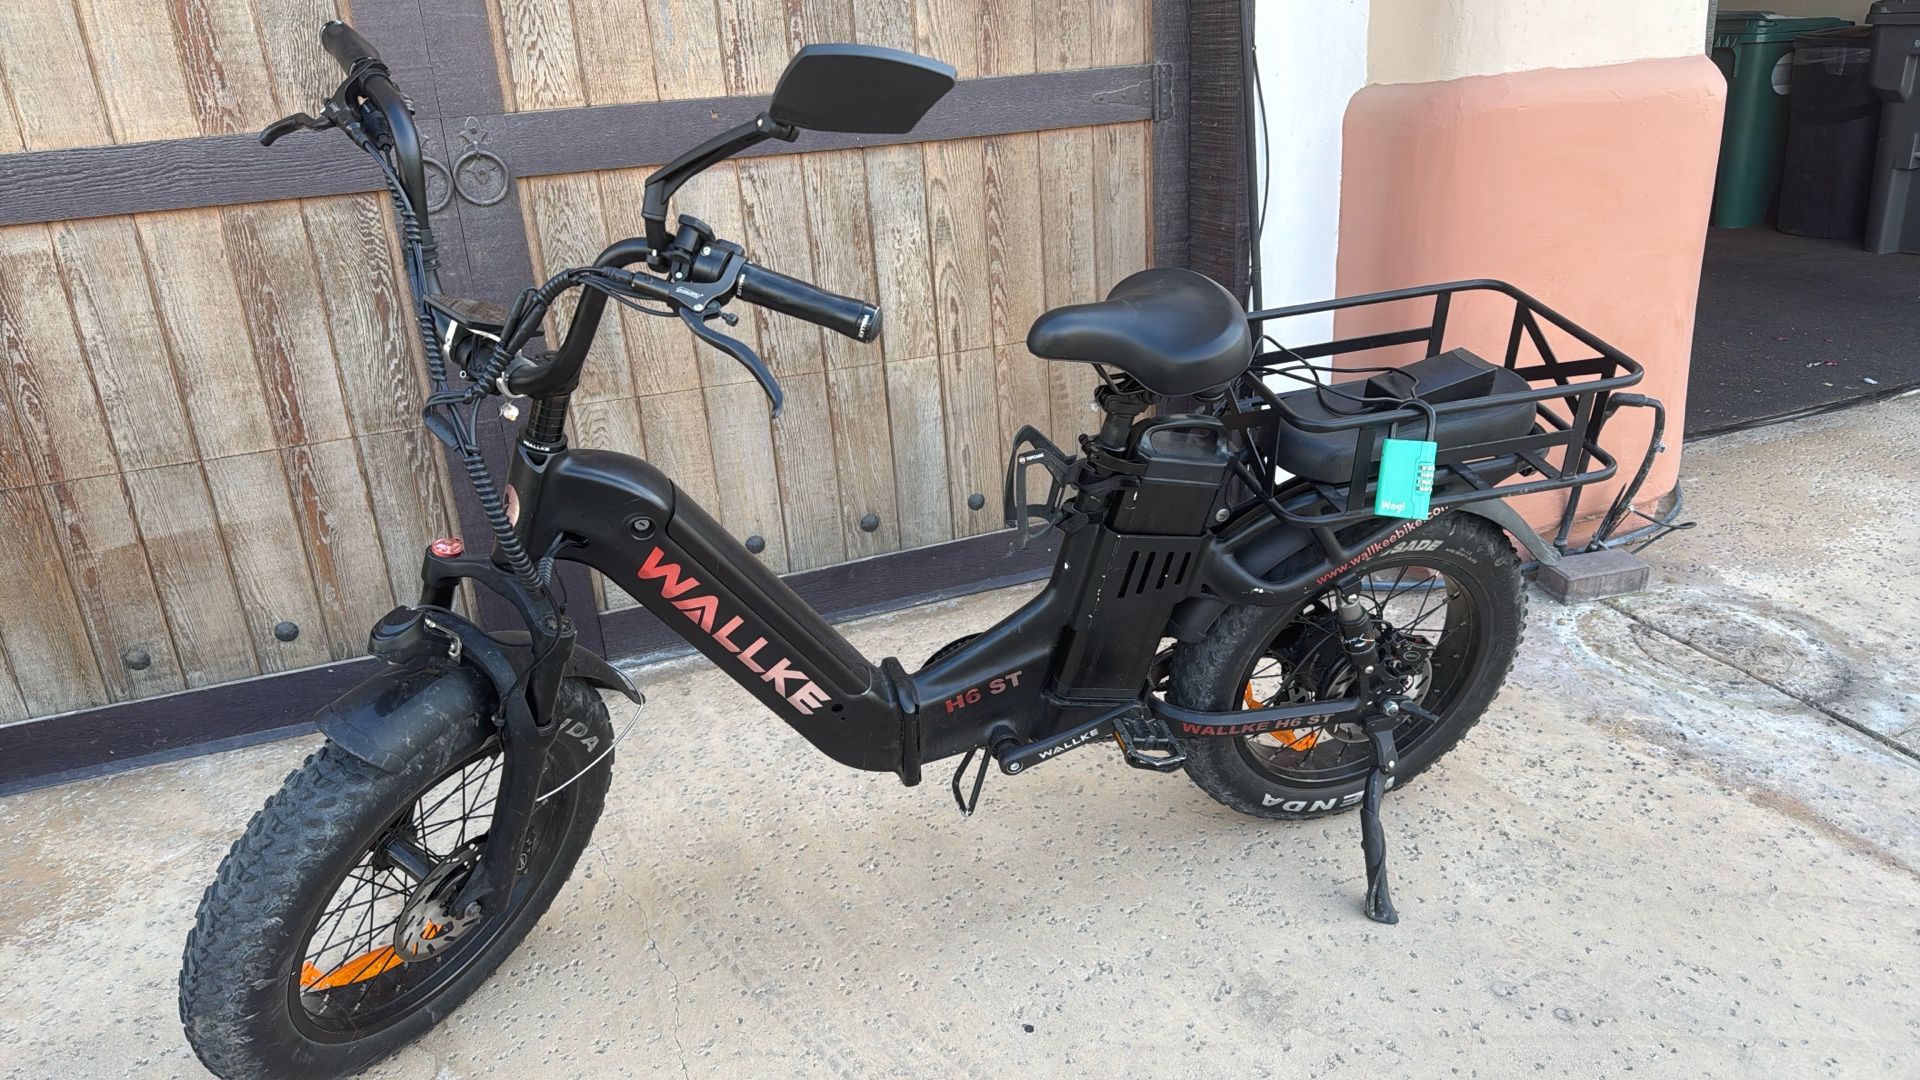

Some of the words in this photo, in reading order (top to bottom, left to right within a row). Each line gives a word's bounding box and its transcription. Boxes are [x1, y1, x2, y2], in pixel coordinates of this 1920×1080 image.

[523, 440, 550, 451] WALLKE
[637, 546, 832, 715] WALLKE
[945, 688, 981, 714] H6
[989, 670, 1022, 695] ST
[1181, 720, 1271, 736] WALLKE
[1275, 717, 1302, 729] H6
[1307, 713, 1335, 725] ST
[1039, 728, 1099, 759] WALLKE
